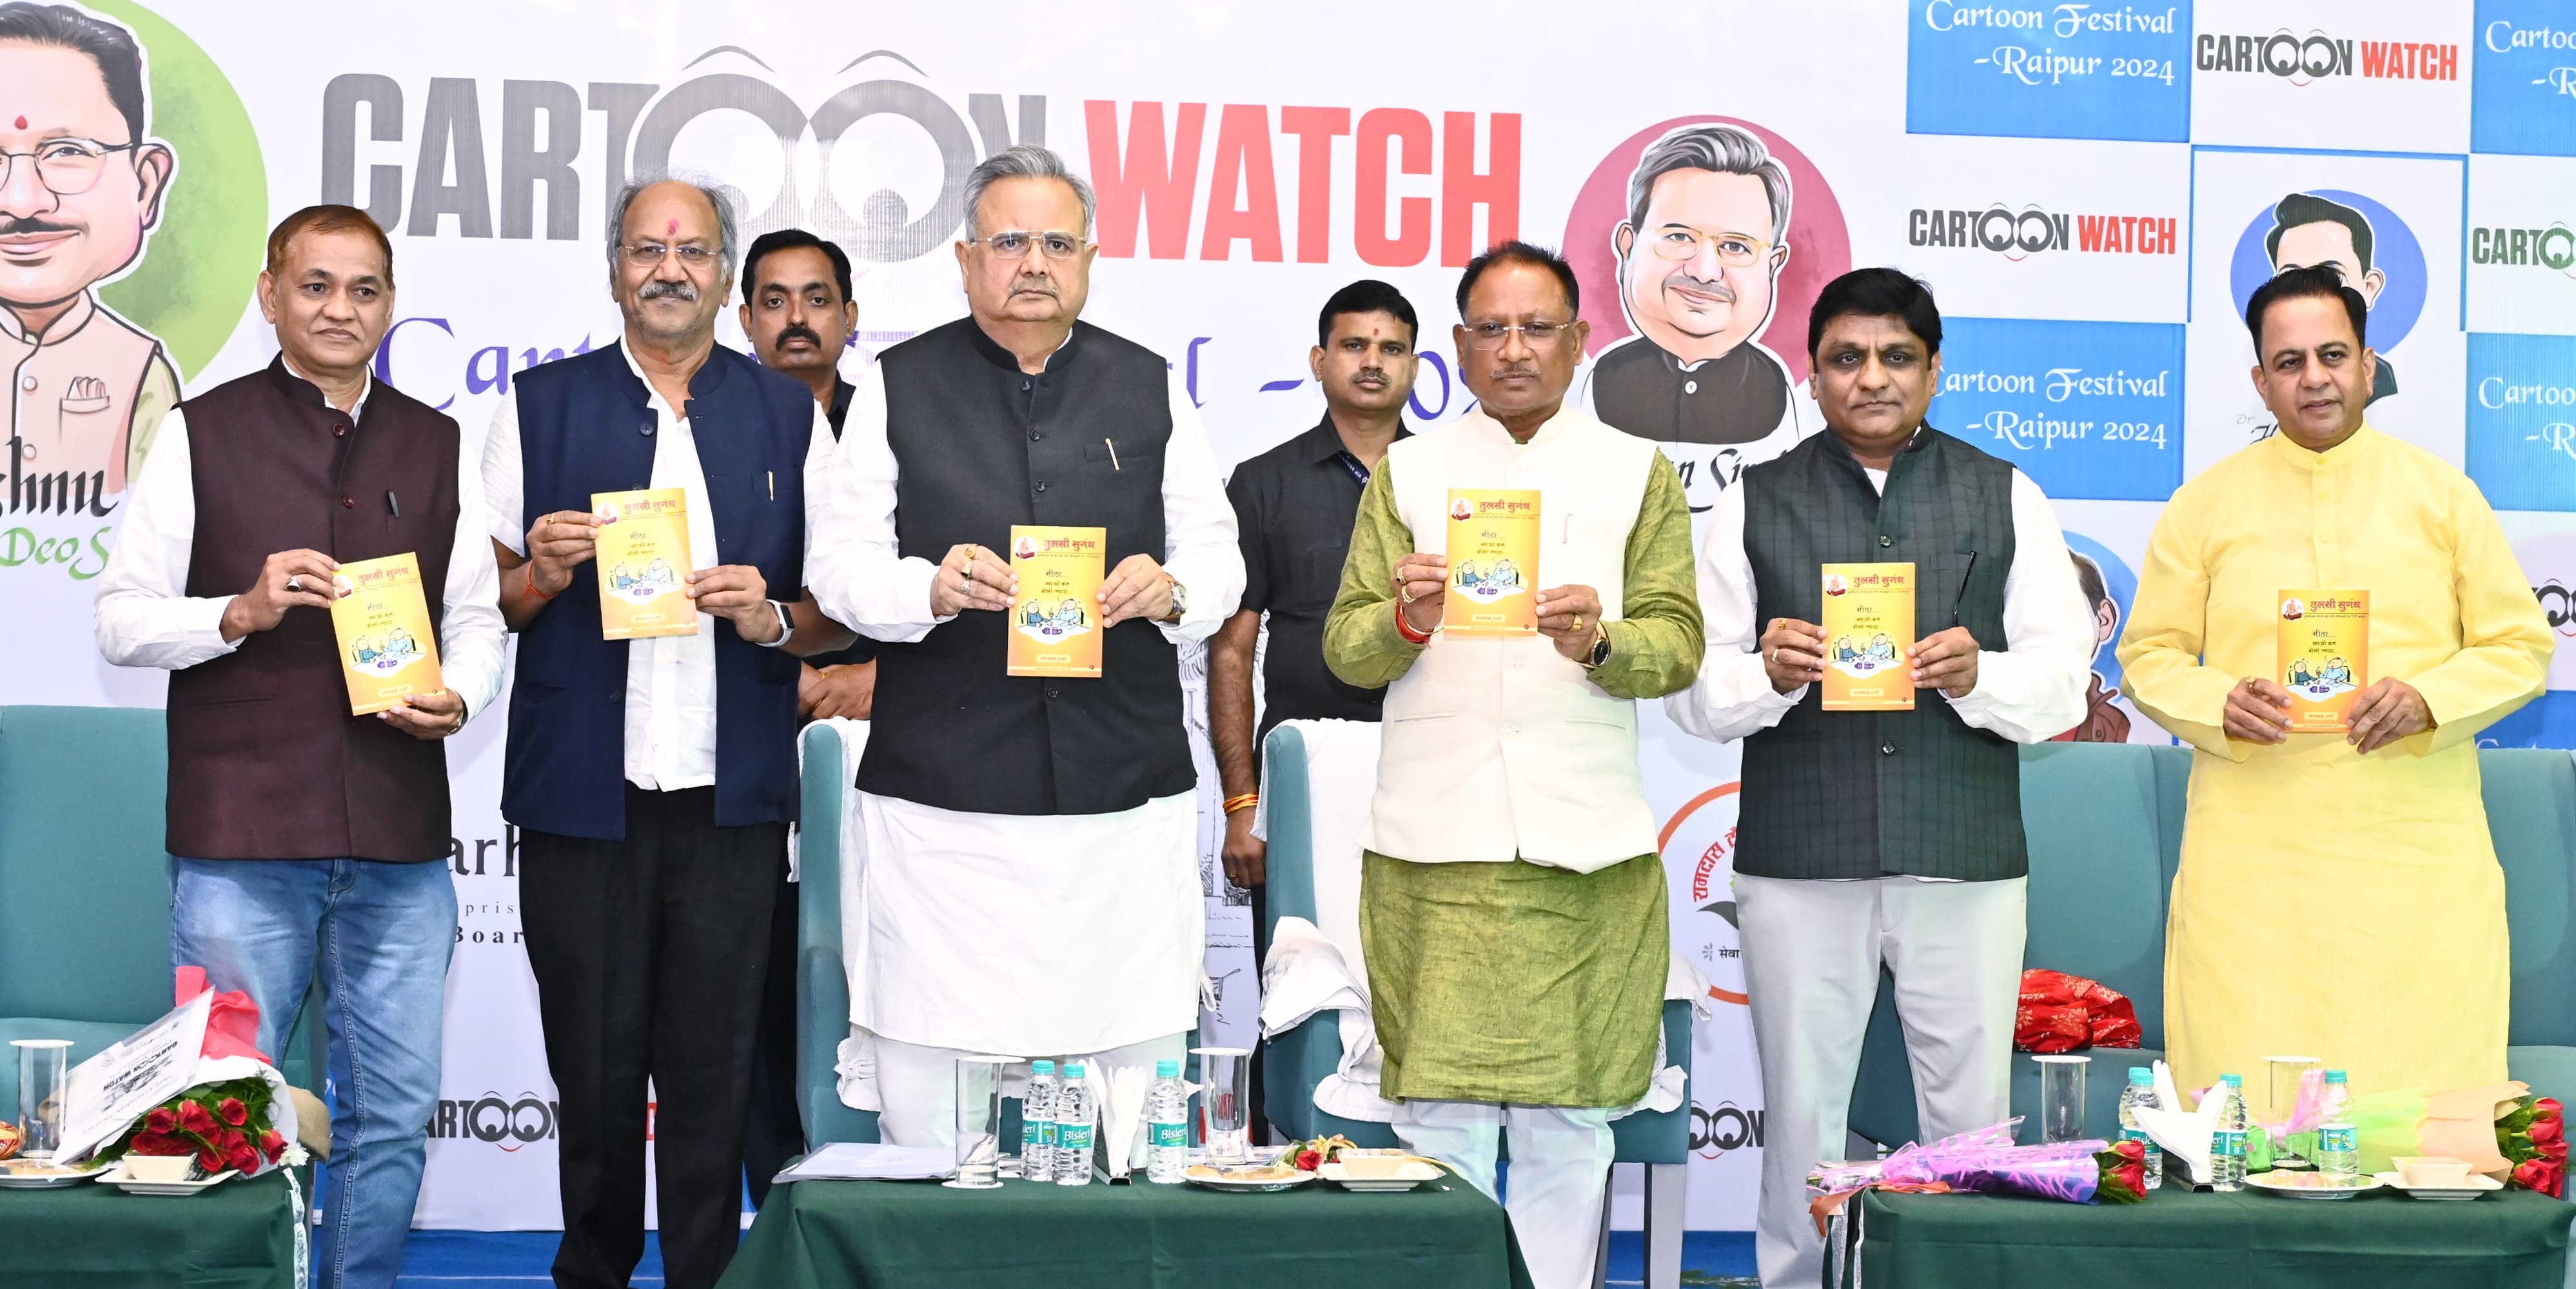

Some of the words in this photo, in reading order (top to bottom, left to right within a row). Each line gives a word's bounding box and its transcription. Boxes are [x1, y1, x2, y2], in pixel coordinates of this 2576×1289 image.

[1925, 0, 2043, 32] Cartoon
[2053, 5, 2178, 38] Festival
[2196, 34, 2353, 77] CARTOON
[2361, 41, 2457, 81] WATCH
[2110, 58, 2175, 86] 2024
[1083, 99, 1521, 268] WATCH
[1909, 208, 2070, 253] CARTOON
[2078, 215, 2176, 254] WATCH
[2473, 227, 2576, 270] CARTO
[1934, 366, 2036, 397] artoon
[2045, 368, 2169, 402] Festival
[2103, 422, 2167, 449] 2024
[624, 500, 650, 515] तुलसी
[653, 498, 676, 512] सुगंध
[1479, 500, 1506, 513] तुलसी
[1508, 500, 1531, 513] सुगंध
[1044, 538, 1070, 551] तुलसी
[1072, 538, 1096, 552] सुगंध
[357, 569, 384, 585] तुलसी
[386, 566, 409, 581] सुगंध
[1853, 574, 1879, 587] तुलसी
[1882, 574, 1904, 587] सुगंध
[2310, 598, 2335, 611] तुलसी
[2338, 598, 2361, 612] सुगंध
[1693, 840, 1726, 903] रामदास
[1719, 945, 1740, 959] सेवा
[103, 1070, 132, 1092] WATCH
